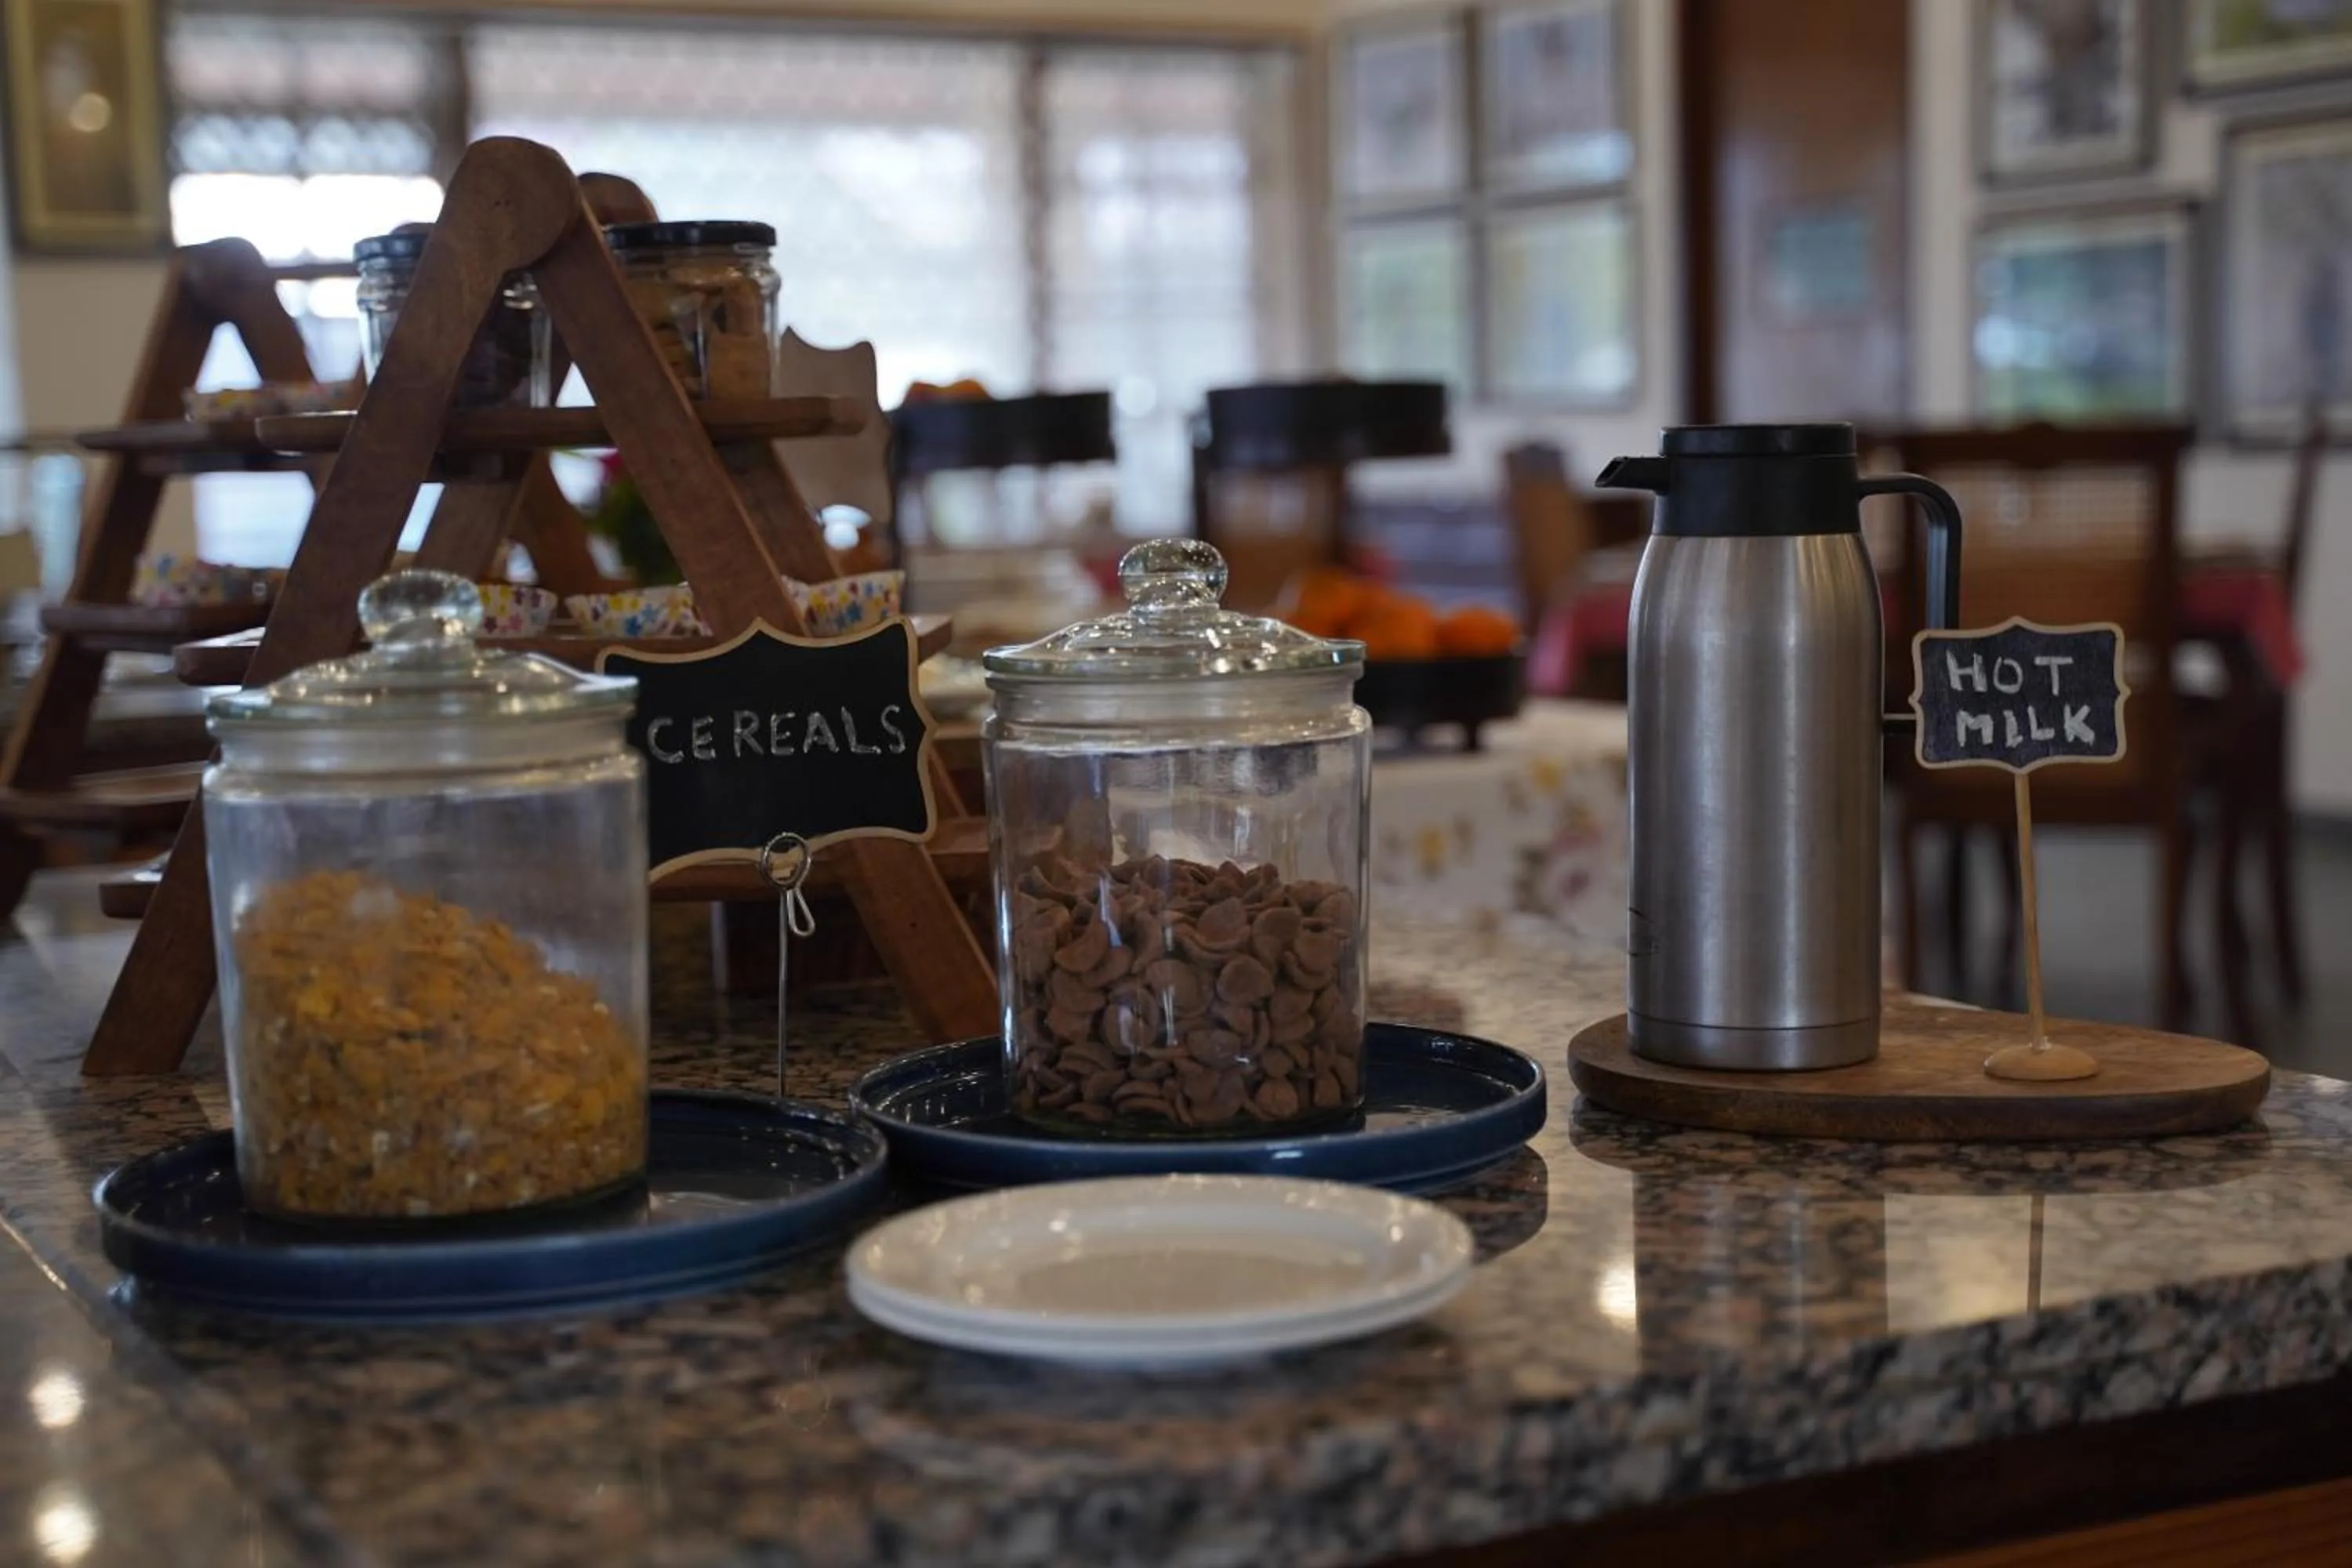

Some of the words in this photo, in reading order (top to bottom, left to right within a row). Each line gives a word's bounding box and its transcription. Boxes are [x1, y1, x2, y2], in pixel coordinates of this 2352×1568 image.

[1946, 649, 2074, 696] HOT
[648, 705, 906, 764] CEREALS
[1956, 704, 2095, 747] MILK
